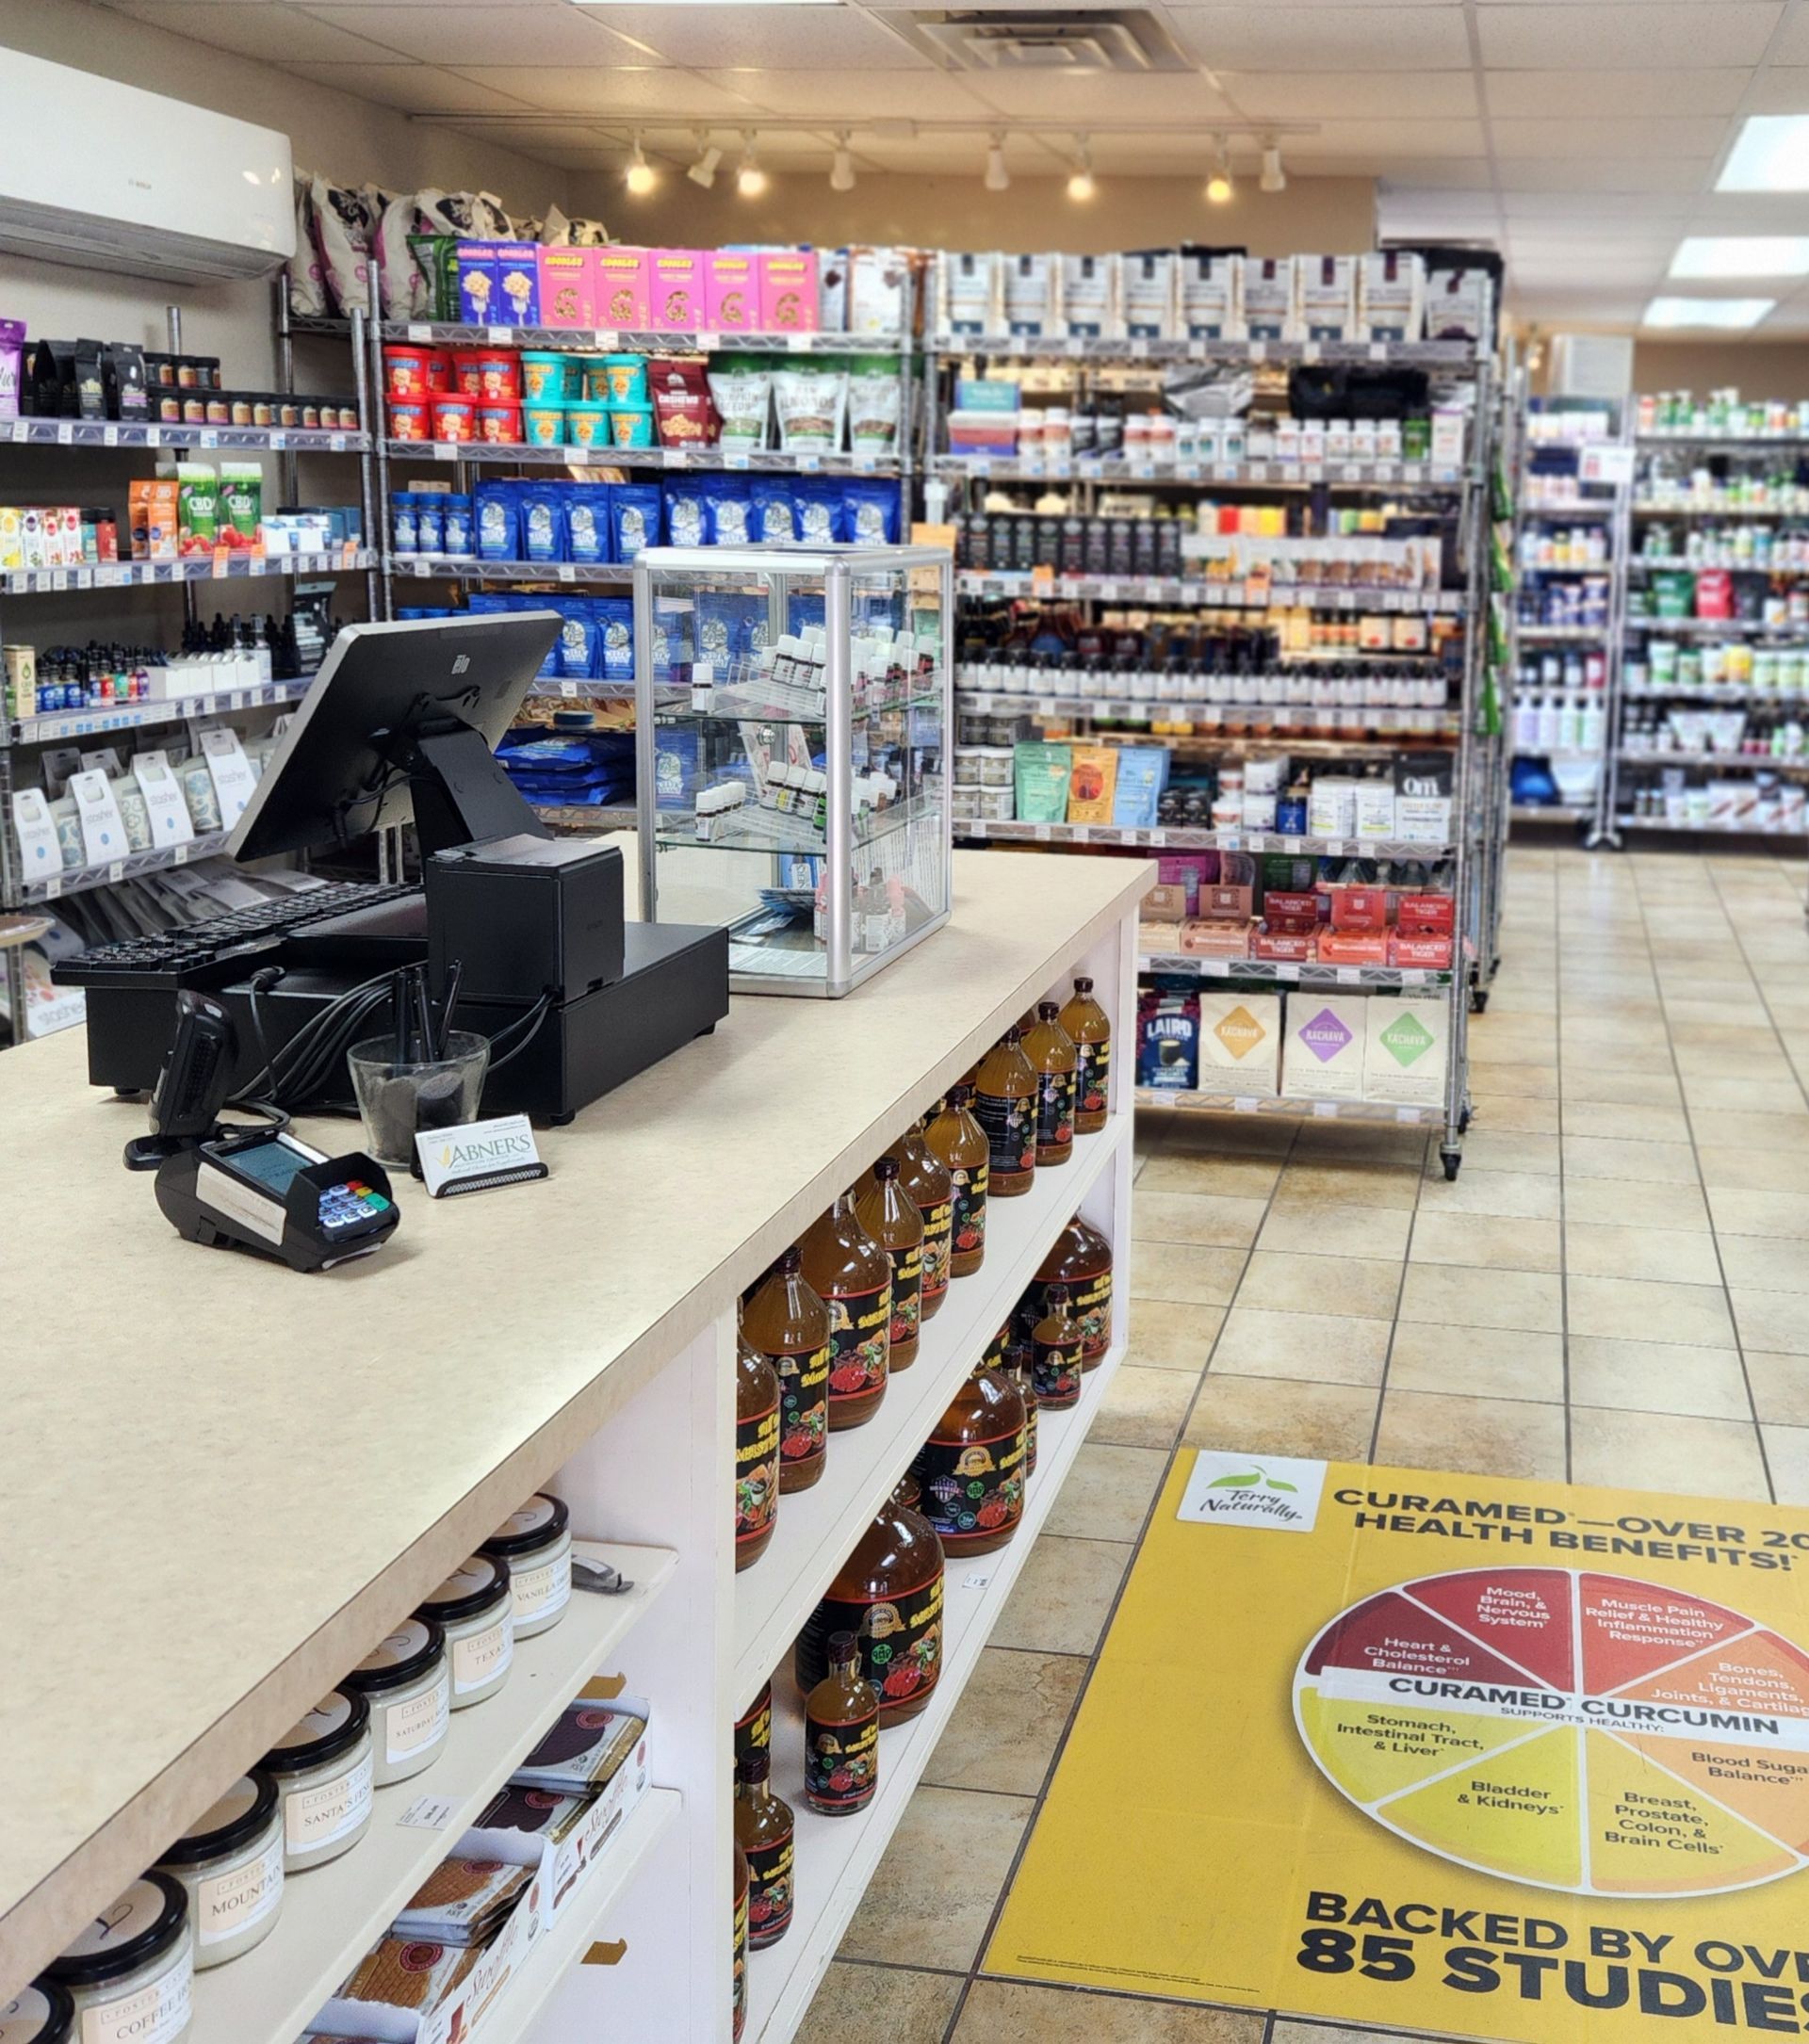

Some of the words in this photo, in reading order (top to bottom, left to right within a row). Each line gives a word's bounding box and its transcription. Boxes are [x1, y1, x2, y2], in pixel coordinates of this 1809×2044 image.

[189, 496, 213, 511] CBD
[228, 495, 252, 510] CBD
[1147, 1017, 1193, 1039] LAIRD
[448, 1134, 531, 1168] ABNER'S
[1225, 1489, 1280, 1504] Terry
[1199, 1498, 1298, 1522] Naturally
[1355, 1512, 1533, 1545] HEALTH
[1480, 1596, 1530, 1609] Brain,
[1535, 1600, 1547, 1610] &
[1486, 1586, 1540, 1600] Mood,
[1476, 1604, 1551, 1620] Nervous
[1602, 1598, 1663, 1614] Muscle
[1667, 1605, 1705, 1618] Pain
[1586, 1607, 1634, 1621] Relief
[1638, 1612, 1651, 1622] &
[1655, 1614, 1724, 1631] Healthy
[1597, 1618, 1714, 1640] Inflammation
[1384, 1637, 1435, 1651] Heart
[1439, 1644, 1452, 1653] &
[1363, 1647, 1471, 1666] Cholesterol
[1718, 1662, 1785, 1679] Bones,
[1708, 1672, 1795, 1691] Tendons,
[1651, 1688, 1714, 1706] Joints,
[1719, 1695, 1732, 1707] &
[1698, 1681, 1804, 1704] Ligaments,
[1366, 1713, 1457, 1734] Stomach,
[1500, 1707, 1585, 1724] SUPPORTS
[1589, 1717, 1665, 1733] HEALTHY:
[1581, 1699, 1780, 1735] CURCUMIN
[1337, 1723, 1426, 1743] Intestinal
[1430, 1733, 1484, 1750] Tract,
[1374, 1741, 1387, 1751] &
[1691, 1751, 1751, 1768] Blood
[1756, 1760, 1809, 1776] Suga
[1457, 1793, 1470, 1804] &
[1471, 1780, 1551, 1799] Bladder
[304, 1793, 353, 1826] SANTA'S
[1623, 1792, 1697, 1811] Breast,
[1614, 1804, 1709, 1826] Prostate,
[1605, 1831, 1660, 1848] Brain
[1619, 1819, 1687, 1839] Colon,
[1692, 1827, 1707, 1840] &
[1306, 1890, 1568, 1951] BACKED
[1589, 1925, 1674, 1964] BY
[1296, 1927, 1417, 1983] 85
[1442, 1945, 1809, 2036] STUDIE
[115, 1990, 161, 2018] FOSTER
[116, 1999, 177, 2041] COFFEE
